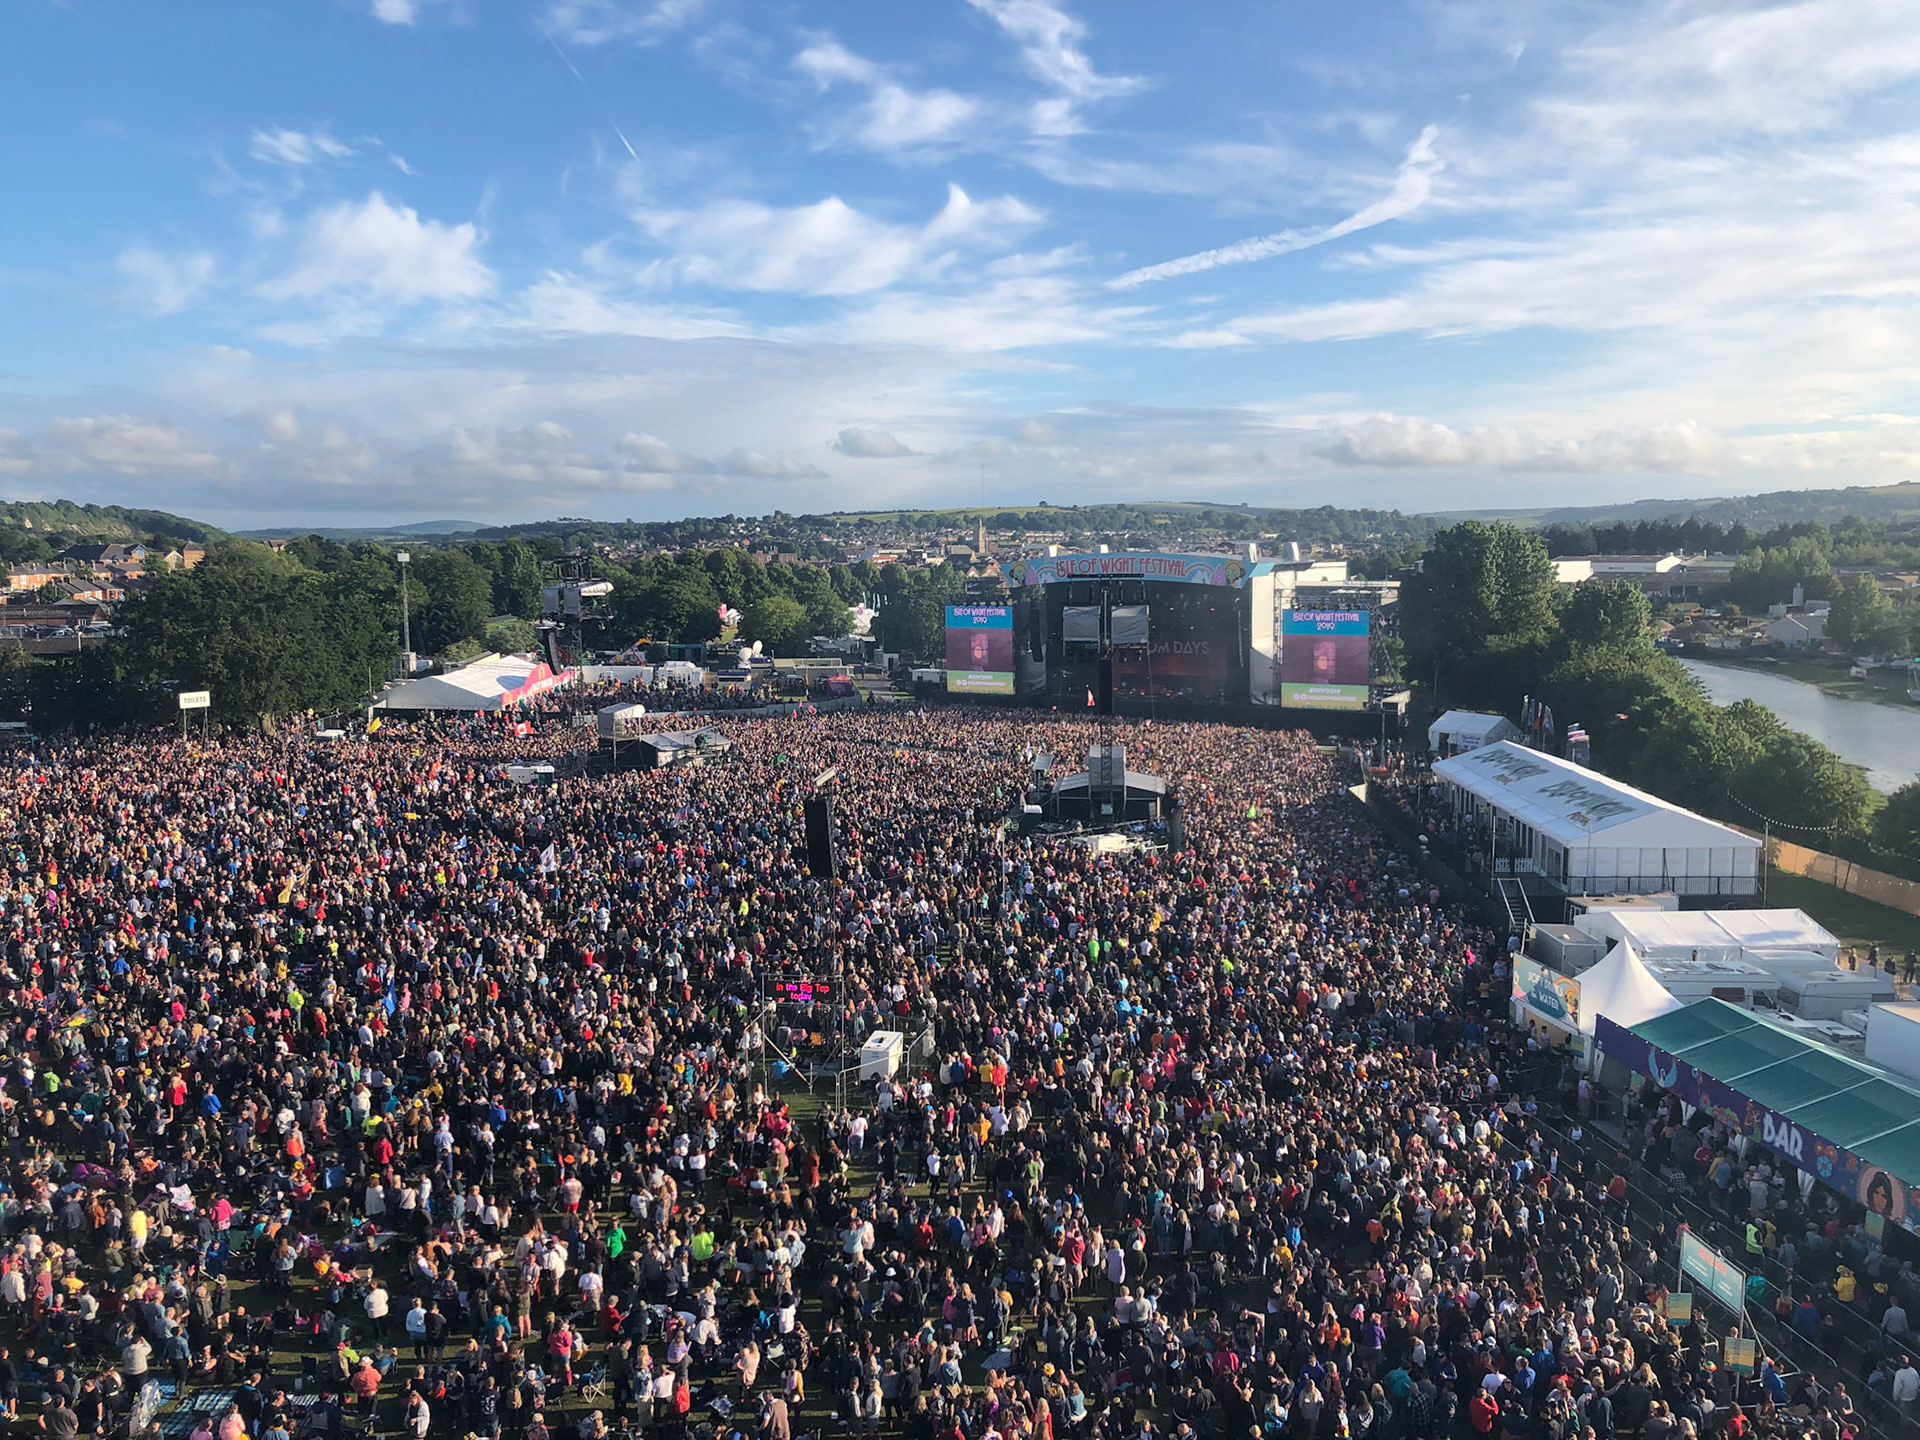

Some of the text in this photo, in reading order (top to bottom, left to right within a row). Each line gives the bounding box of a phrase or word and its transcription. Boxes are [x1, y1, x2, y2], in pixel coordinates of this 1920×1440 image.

[1056, 557, 1186, 578] ISLE OF WIGHT FESTIVAL
[972, 608, 986, 616] WIGHT
[987, 608, 1006, 616] FESTIVAL
[1304, 612, 1314, 621] OF
[1315, 612, 1333, 622] WIGHT
[1335, 612, 1359, 622] FESTIVAL
[972, 616, 987, 624] 2019
[1317, 622, 1335, 631] 2019
[1173, 640, 1209, 655] DAYS
[183, 695, 206, 704] TOILETS
[785, 983, 798, 991] the
[800, 983, 813, 993] Big
[815, 983, 830, 994] Top
[790, 992, 812, 1000] today
[1539, 991, 1559, 1011] WATER
[1763, 1111, 1804, 1163] BAR
